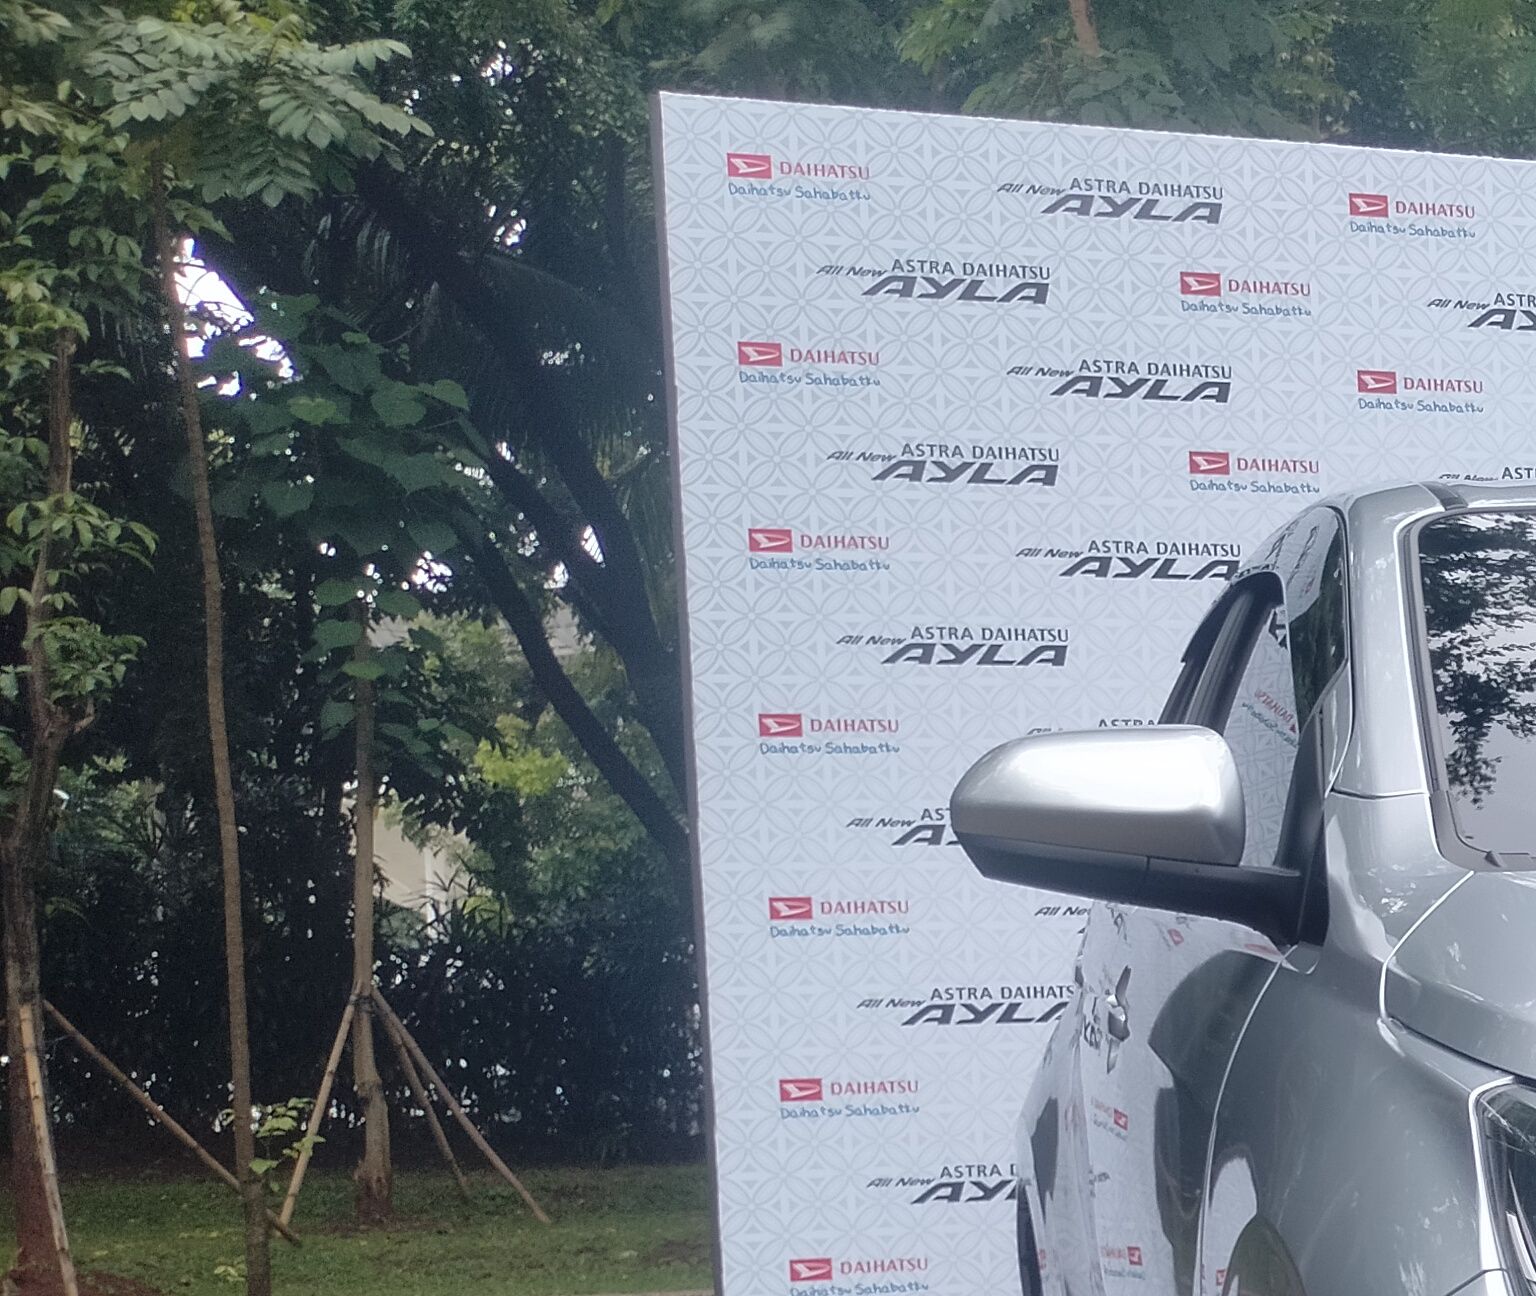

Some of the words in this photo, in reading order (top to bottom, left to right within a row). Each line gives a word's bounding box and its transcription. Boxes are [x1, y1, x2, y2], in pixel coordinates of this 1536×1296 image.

[780, 161, 870, 180] DAIHATSU
[728, 182, 791, 197] Daihatsu
[997, 183, 1023, 193] All
[1025, 185, 1066, 196] New
[1069, 177, 1131, 194] ASTRA
[1138, 181, 1224, 200] DAIHATSU
[1040, 193, 1223, 224] AYLA
[1396, 201, 1475, 219] DAIHATSU
[1349, 220, 1406, 234] Daihatsu
[816, 265, 843, 275] All
[845, 266, 888, 277] New
[891, 259, 955, 275] ASTRA
[962, 262, 1051, 280] DAIHATSU
[861, 275, 1050, 305] AYLA
[1228, 279, 1311, 296] DAIHATSU
[1181, 300, 1239, 313] Daihatsu
[1427, 298, 1451, 308] All
[1453, 300, 1490, 310] New
[790, 349, 880, 366] DAIHATSU
[1006, 366, 1032, 375] All
[1034, 367, 1075, 378] New
[1078, 359, 1140, 375] ASTRA
[1147, 362, 1232, 379] DAIHATSU
[738, 371, 802, 384] Daihatsu
[1404, 377, 1483, 393] DAIHATSU
[1049, 375, 1231, 403] AYLA
[1358, 397, 1414, 410] Daihatsu
[826, 450, 853, 460] All
[855, 452, 897, 462] New
[901, 443, 965, 458] ASTRA
[972, 445, 1060, 462] DAIHATSU
[871, 459, 1059, 486] AYLA
[1237, 458, 1320, 474] DAIHATSU
[1189, 479, 1248, 491] Daihatsu
[801, 534, 890, 550] DAIHATSU
[1015, 547, 1042, 557] All
[1043, 548, 1084, 558] New
[1088, 540, 1149, 554] ASTRA
[1156, 541, 1241, 557] DAIHATSU
[749, 557, 812, 570] Daihatsu
[1058, 556, 1240, 581] AYLA
[836, 634, 863, 645] All
[865, 636, 907, 646] New
[910, 626, 974, 640] ASTRA
[981, 627, 1069, 642] DAIHATSU
[880, 643, 1068, 667] AYLA
[811, 719, 899, 732] DAIHATSU
[759, 742, 822, 755] Daihatsu
[846, 818, 874, 828] All
[875, 817, 917, 828] New
[821, 900, 909, 914] DAIHATSU
[1034, 906, 1061, 916] All
[769, 926, 832, 938] Daihatsu
[856, 998, 883, 1009] All
[885, 999, 927, 1009] New
[930, 987, 993, 1002] ASTRA
[1000, 984, 1075, 1000] DAIHATS
[831, 1079, 919, 1095] DAIHATSU
[780, 1108, 842, 1120] Daihatsu
[866, 1177, 893, 1188] All
[894, 1177, 936, 1188] New
[939, 1164, 1002, 1180] ASTRA
[841, 1257, 929, 1274] DAIHATSU
